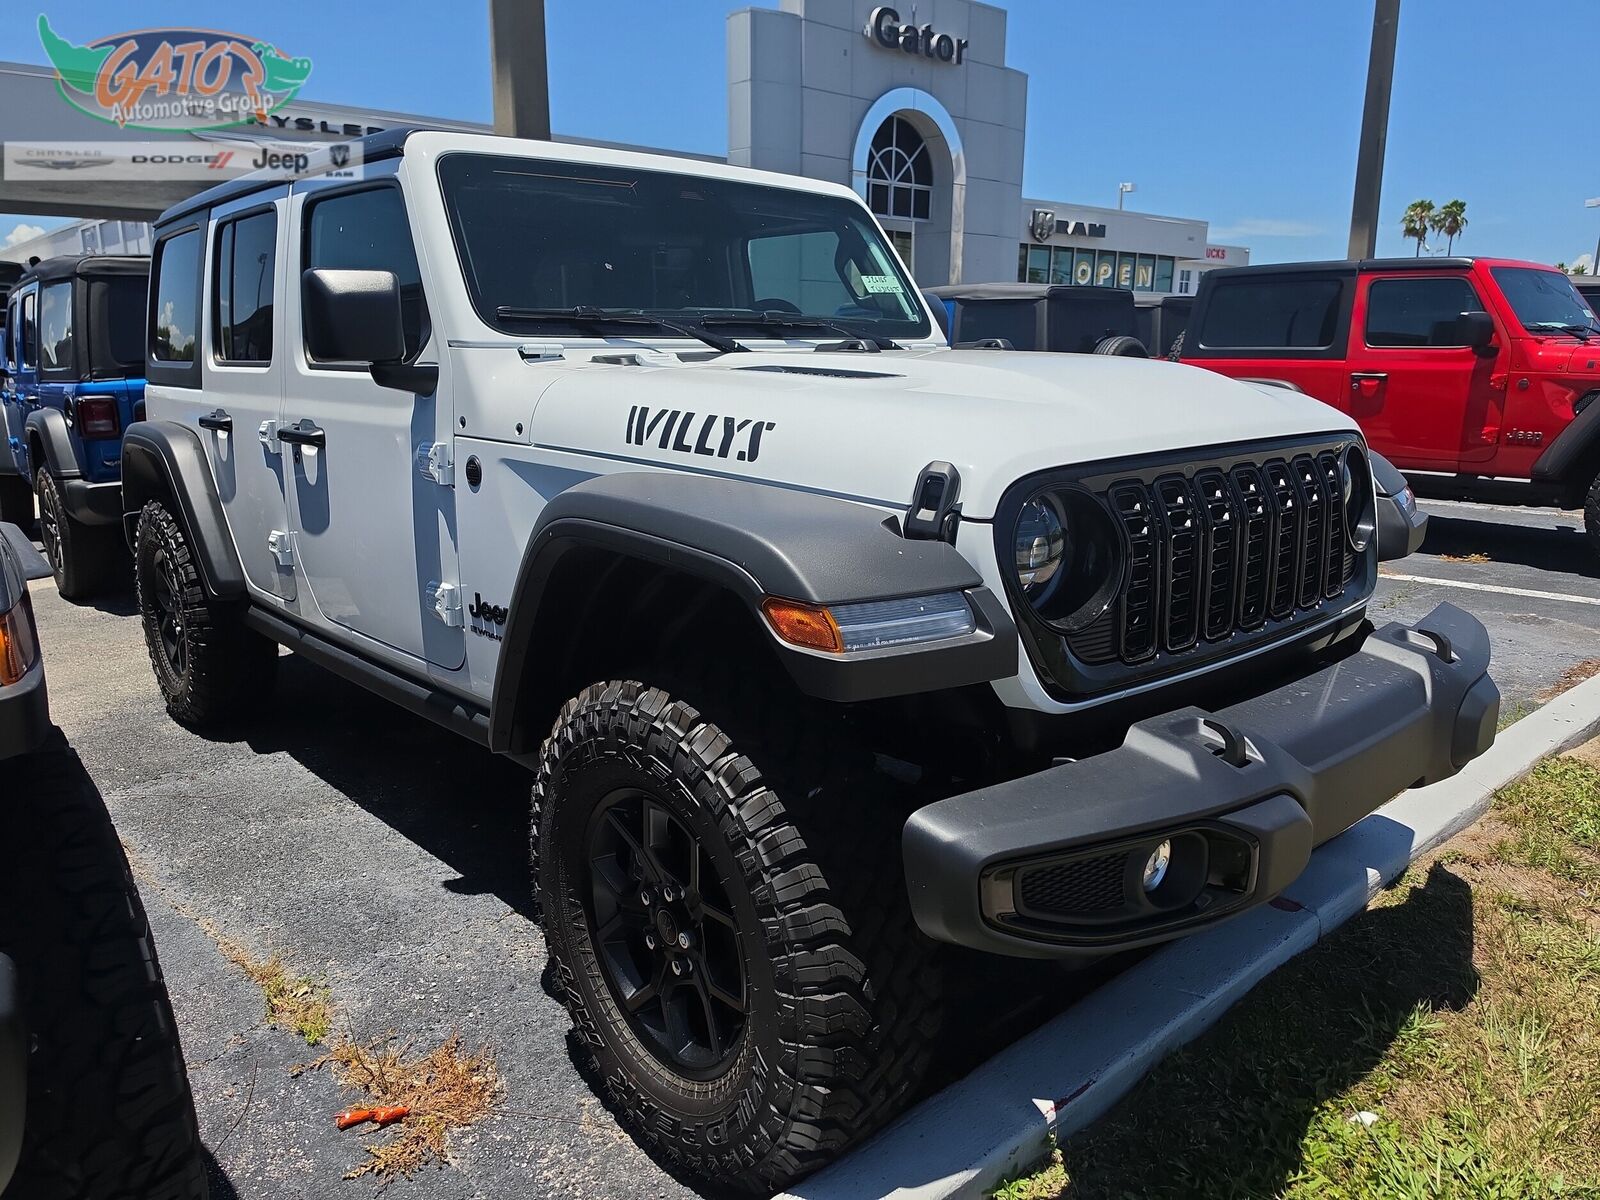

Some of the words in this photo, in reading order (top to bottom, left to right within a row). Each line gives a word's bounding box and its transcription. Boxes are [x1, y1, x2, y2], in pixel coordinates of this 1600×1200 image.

[870, 6, 968, 65] Gator
[1055, 219, 1106, 239] RAM
[1075, 261, 1153, 288] OPEN
[625, 405, 777, 462] WILLYS
[1506, 428, 1543, 441] Jeep
